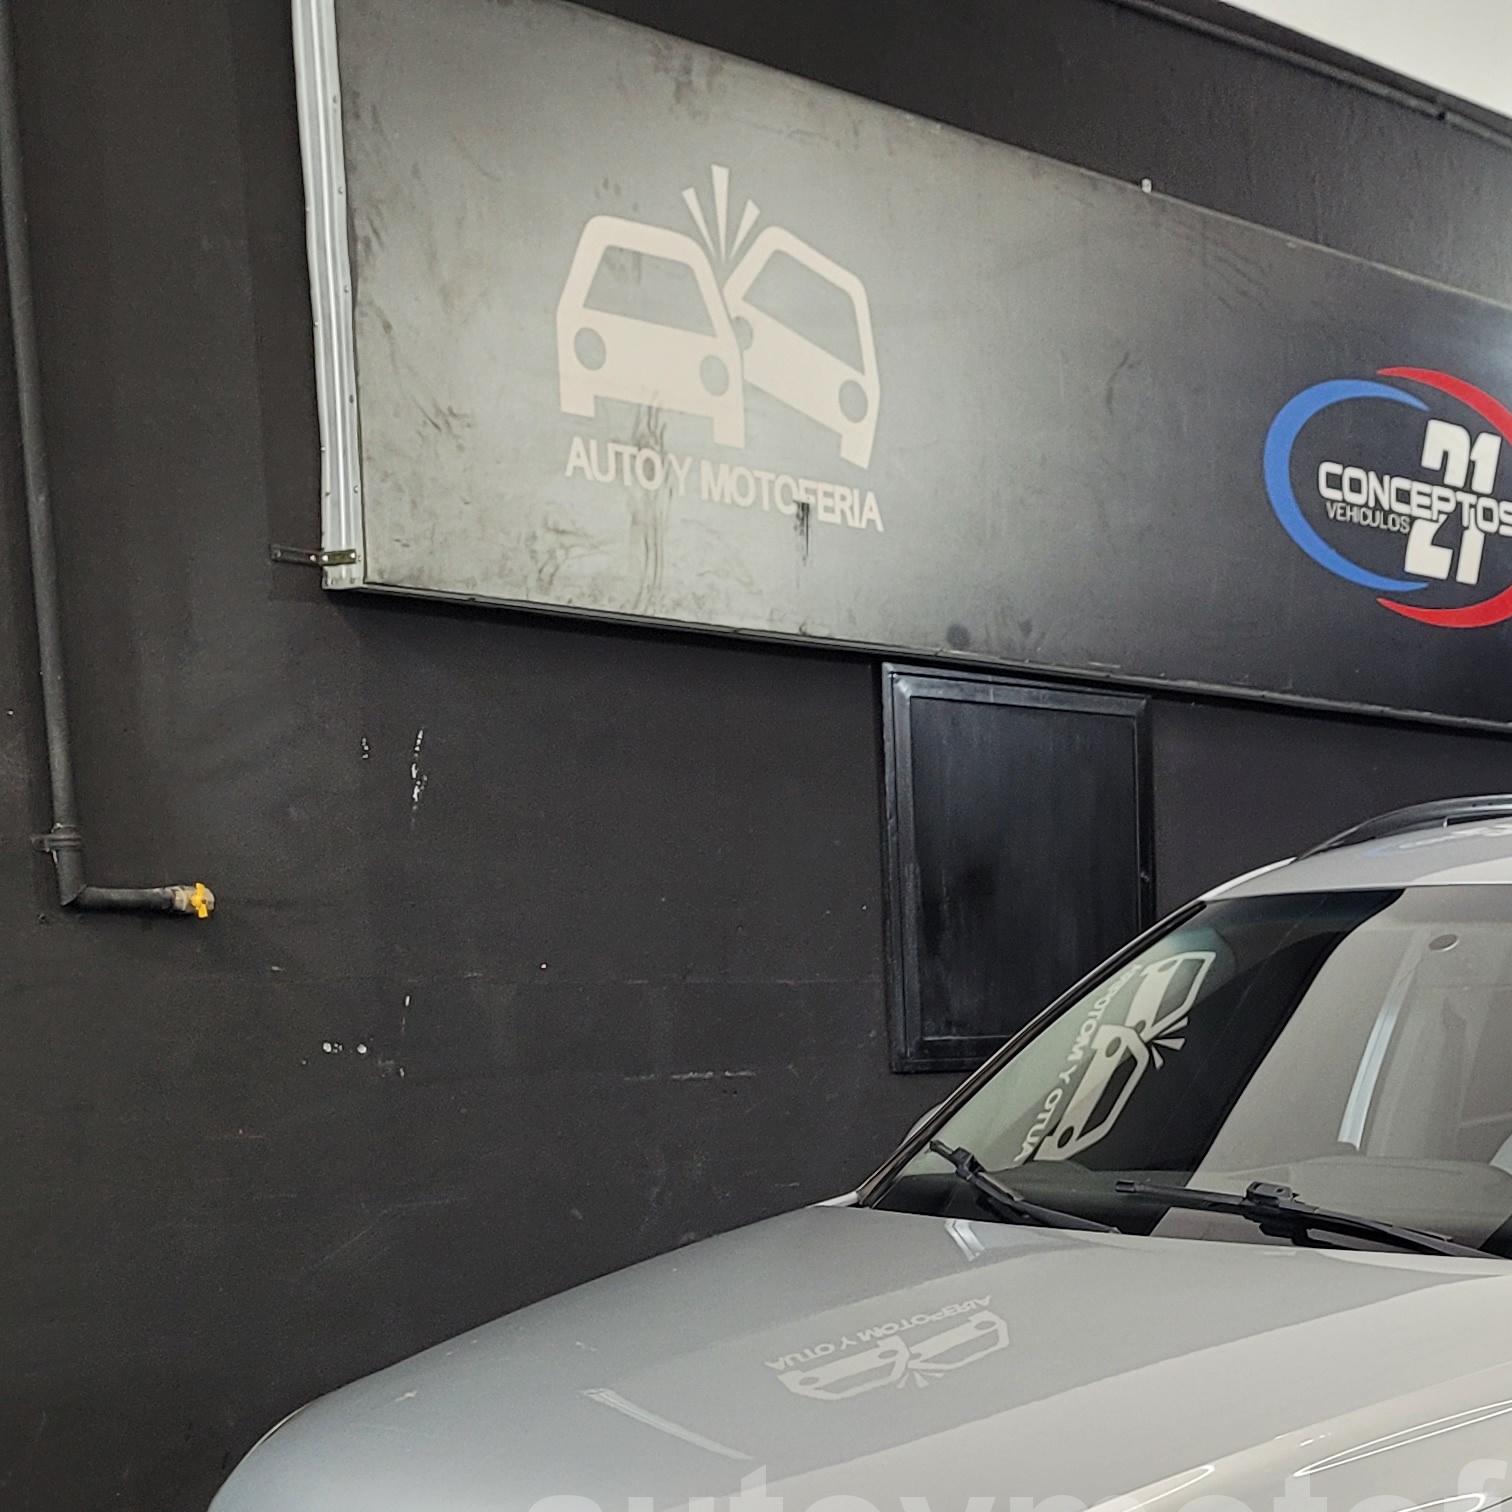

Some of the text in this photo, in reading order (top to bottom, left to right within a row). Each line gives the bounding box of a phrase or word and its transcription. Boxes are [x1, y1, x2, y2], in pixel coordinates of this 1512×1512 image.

[564, 436, 884, 532] AUTO Y MOTOFERIA
